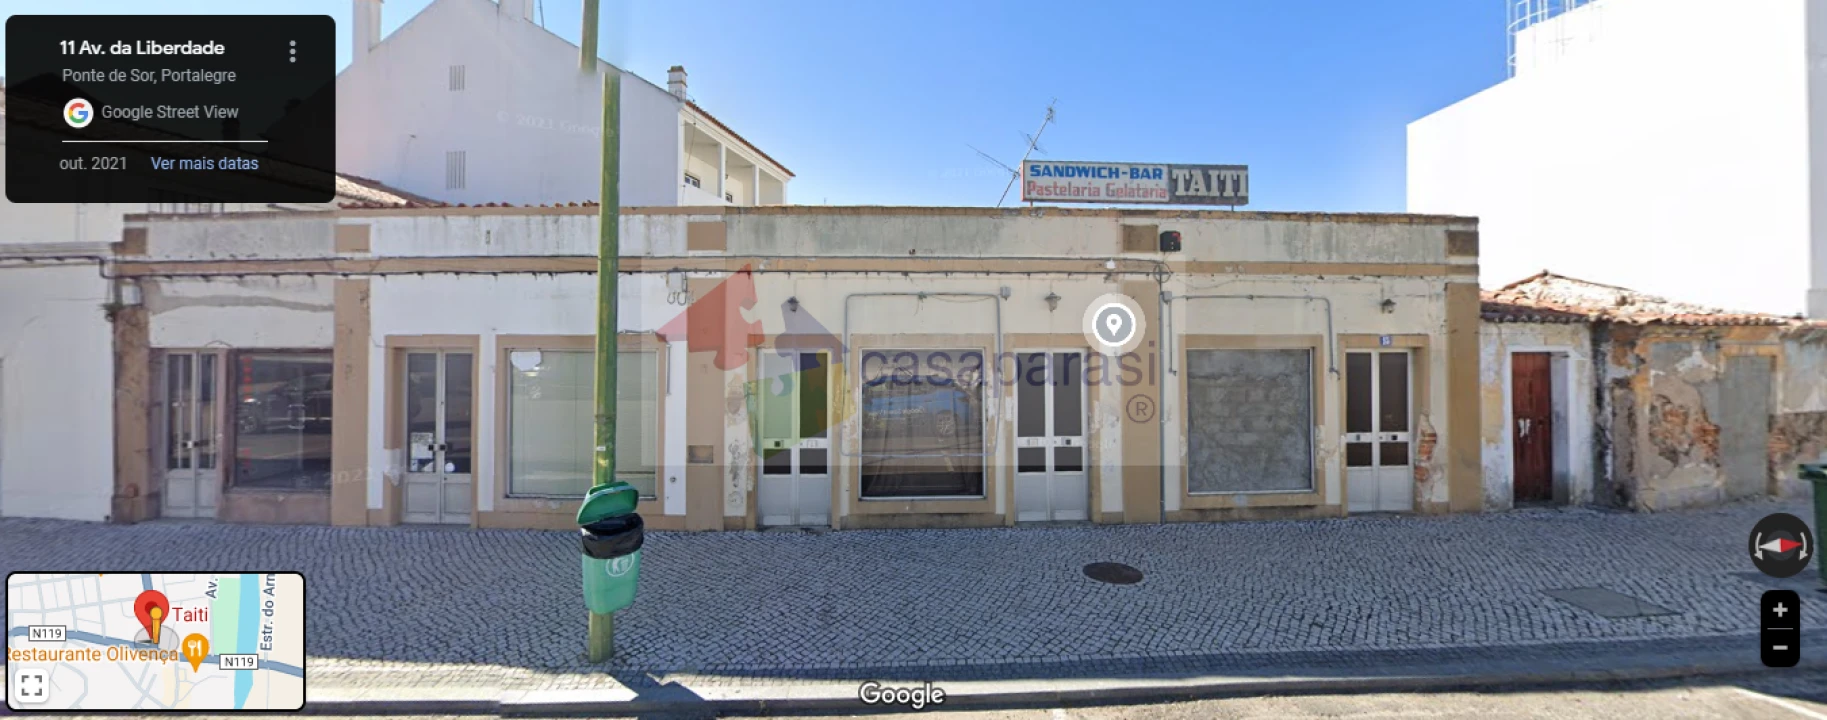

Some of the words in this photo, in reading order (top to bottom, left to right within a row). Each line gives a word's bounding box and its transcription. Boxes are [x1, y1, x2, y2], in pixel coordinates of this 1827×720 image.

[1029, 164, 1164, 181] SANDWICH-BAR
[1026, 180, 1100, 197] Pastelaria
[1105, 182, 1168, 199] Gelataria
[1171, 168, 1248, 197] TAITI
